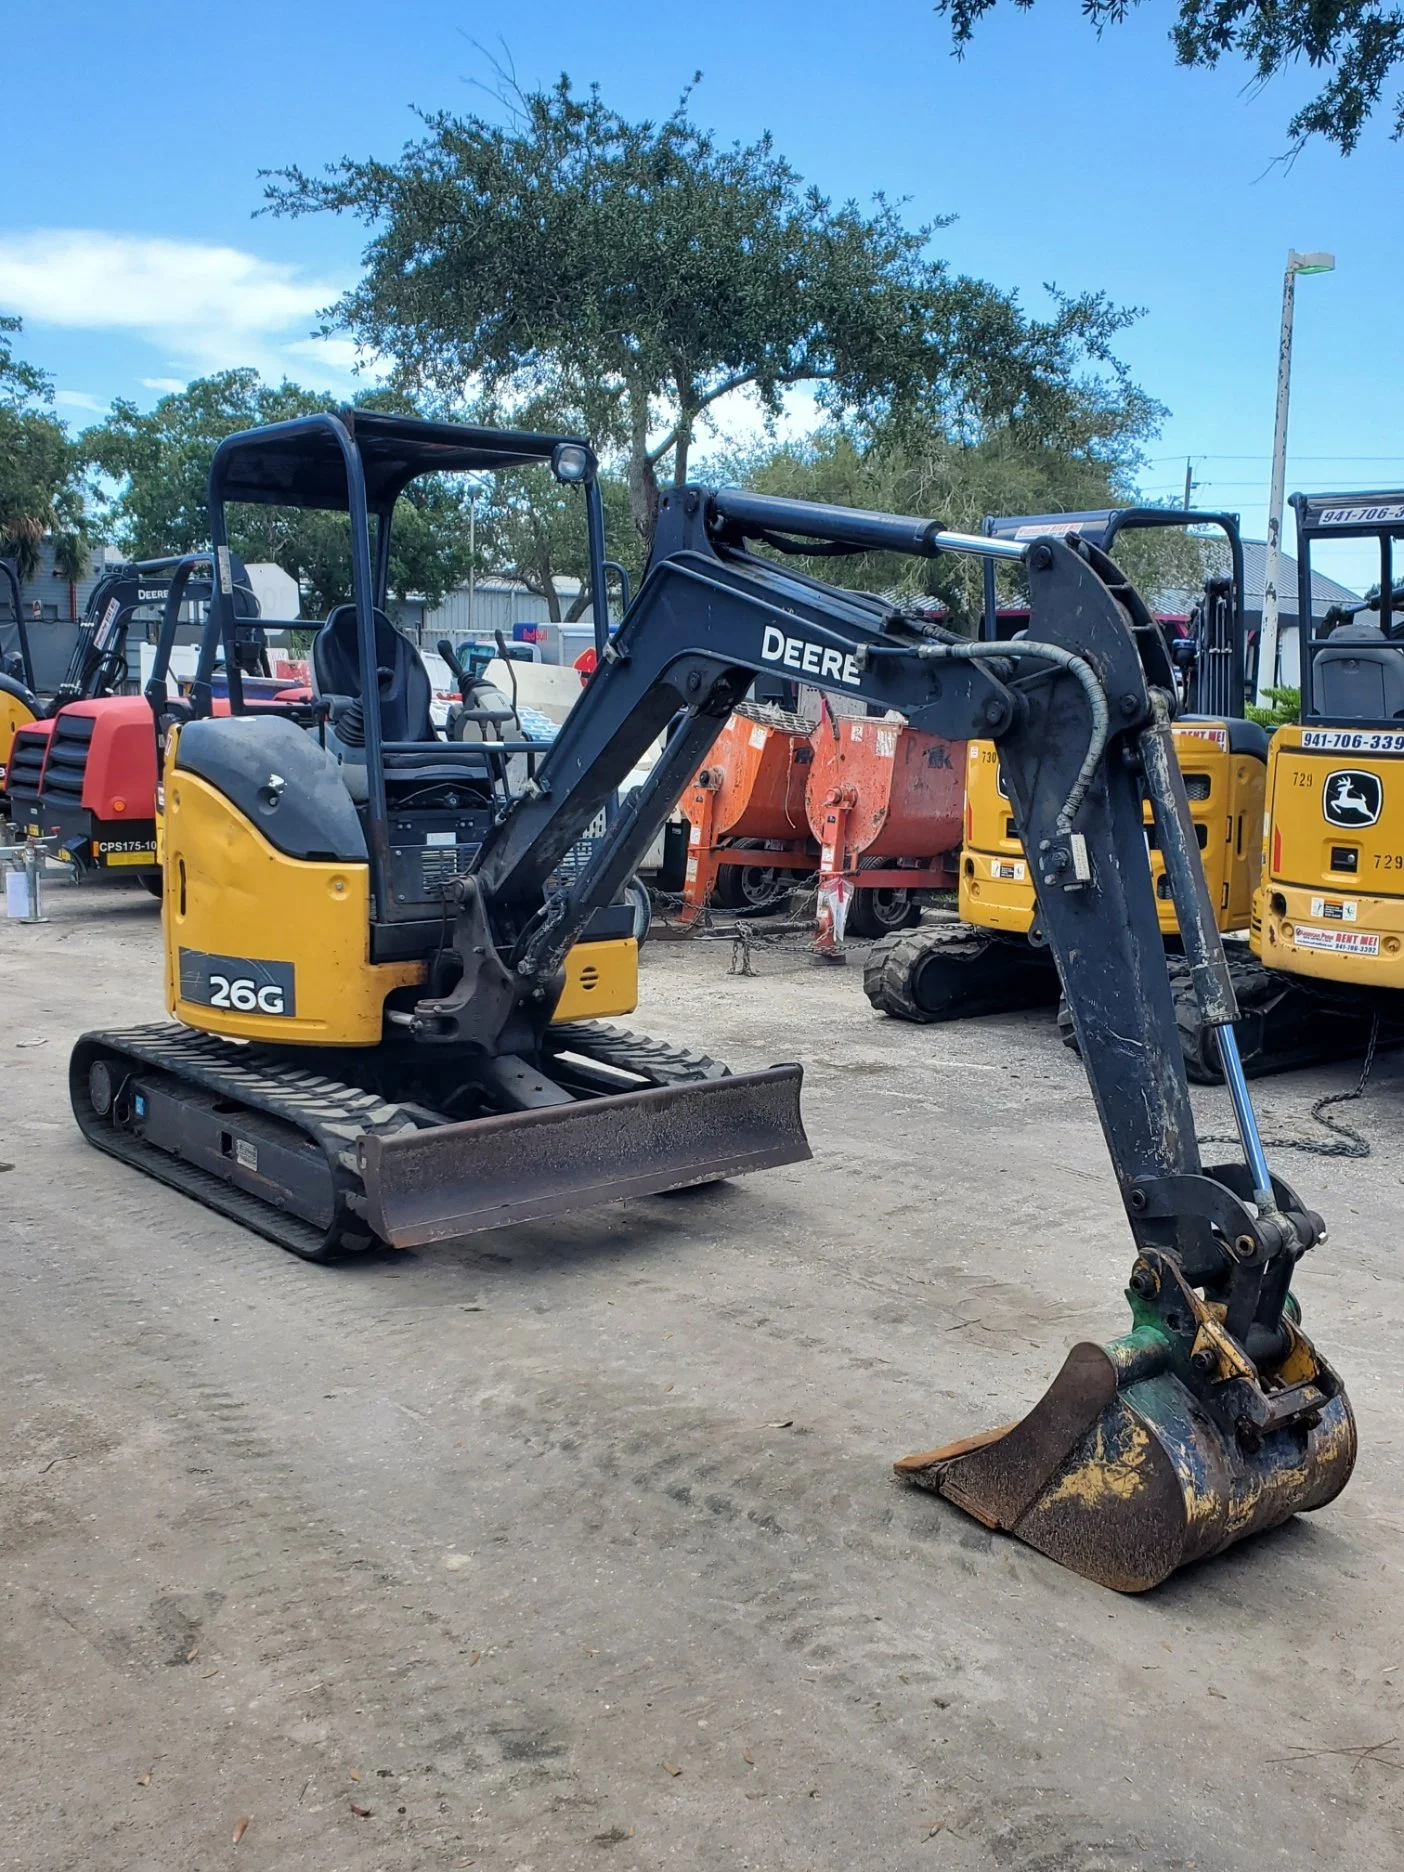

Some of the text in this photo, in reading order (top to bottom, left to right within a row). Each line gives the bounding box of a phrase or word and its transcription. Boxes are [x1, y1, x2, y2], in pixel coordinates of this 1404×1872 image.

[138, 589, 169, 600] DEERE
[761, 625, 861, 686] DEERE
[1304, 733, 1404, 750] 941-706-339
[982, 751, 997, 764] 730
[1293, 771, 1313, 787] 729
[100, 841, 157, 852] CPS175-10
[1373, 854, 1403, 870] 729
[1335, 933, 1359, 945] RENT
[1360, 935, 1378, 947] ME!
[210, 976, 284, 1014] 26G
